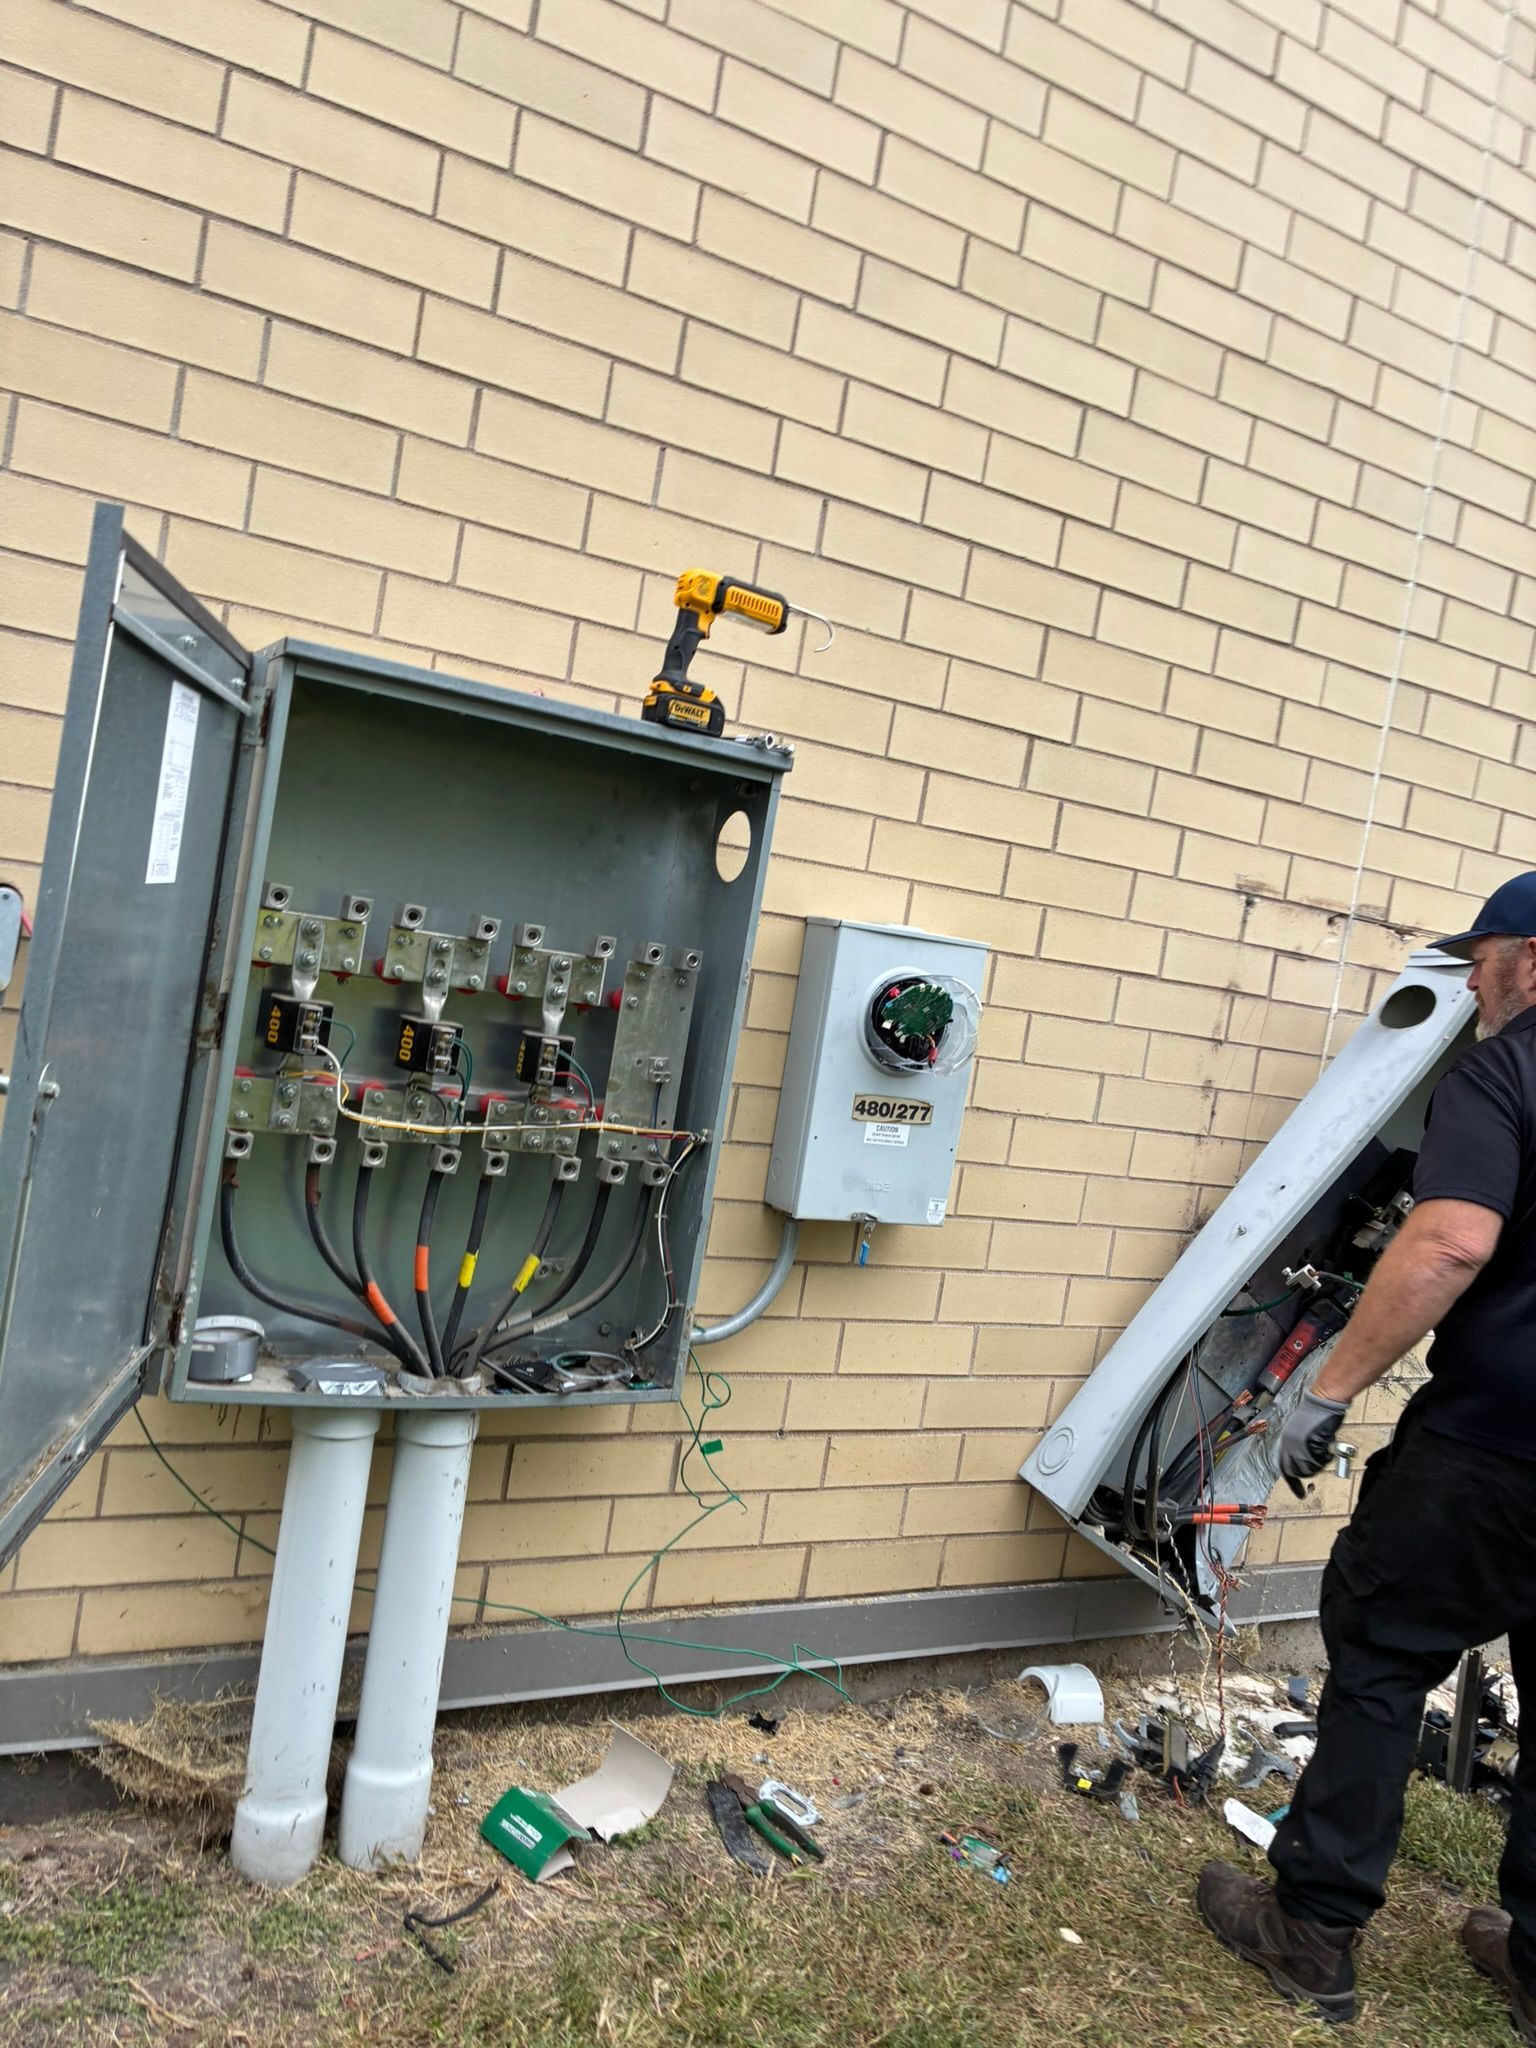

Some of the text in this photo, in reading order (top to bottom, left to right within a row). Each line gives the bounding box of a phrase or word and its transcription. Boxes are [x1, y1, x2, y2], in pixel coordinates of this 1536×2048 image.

[268, 1004, 281, 1043] 400
[399, 1024, 415, 1061] 400
[855, 1100, 931, 1121] 480/277
[876, 1124, 899, 1133] CAUTION
